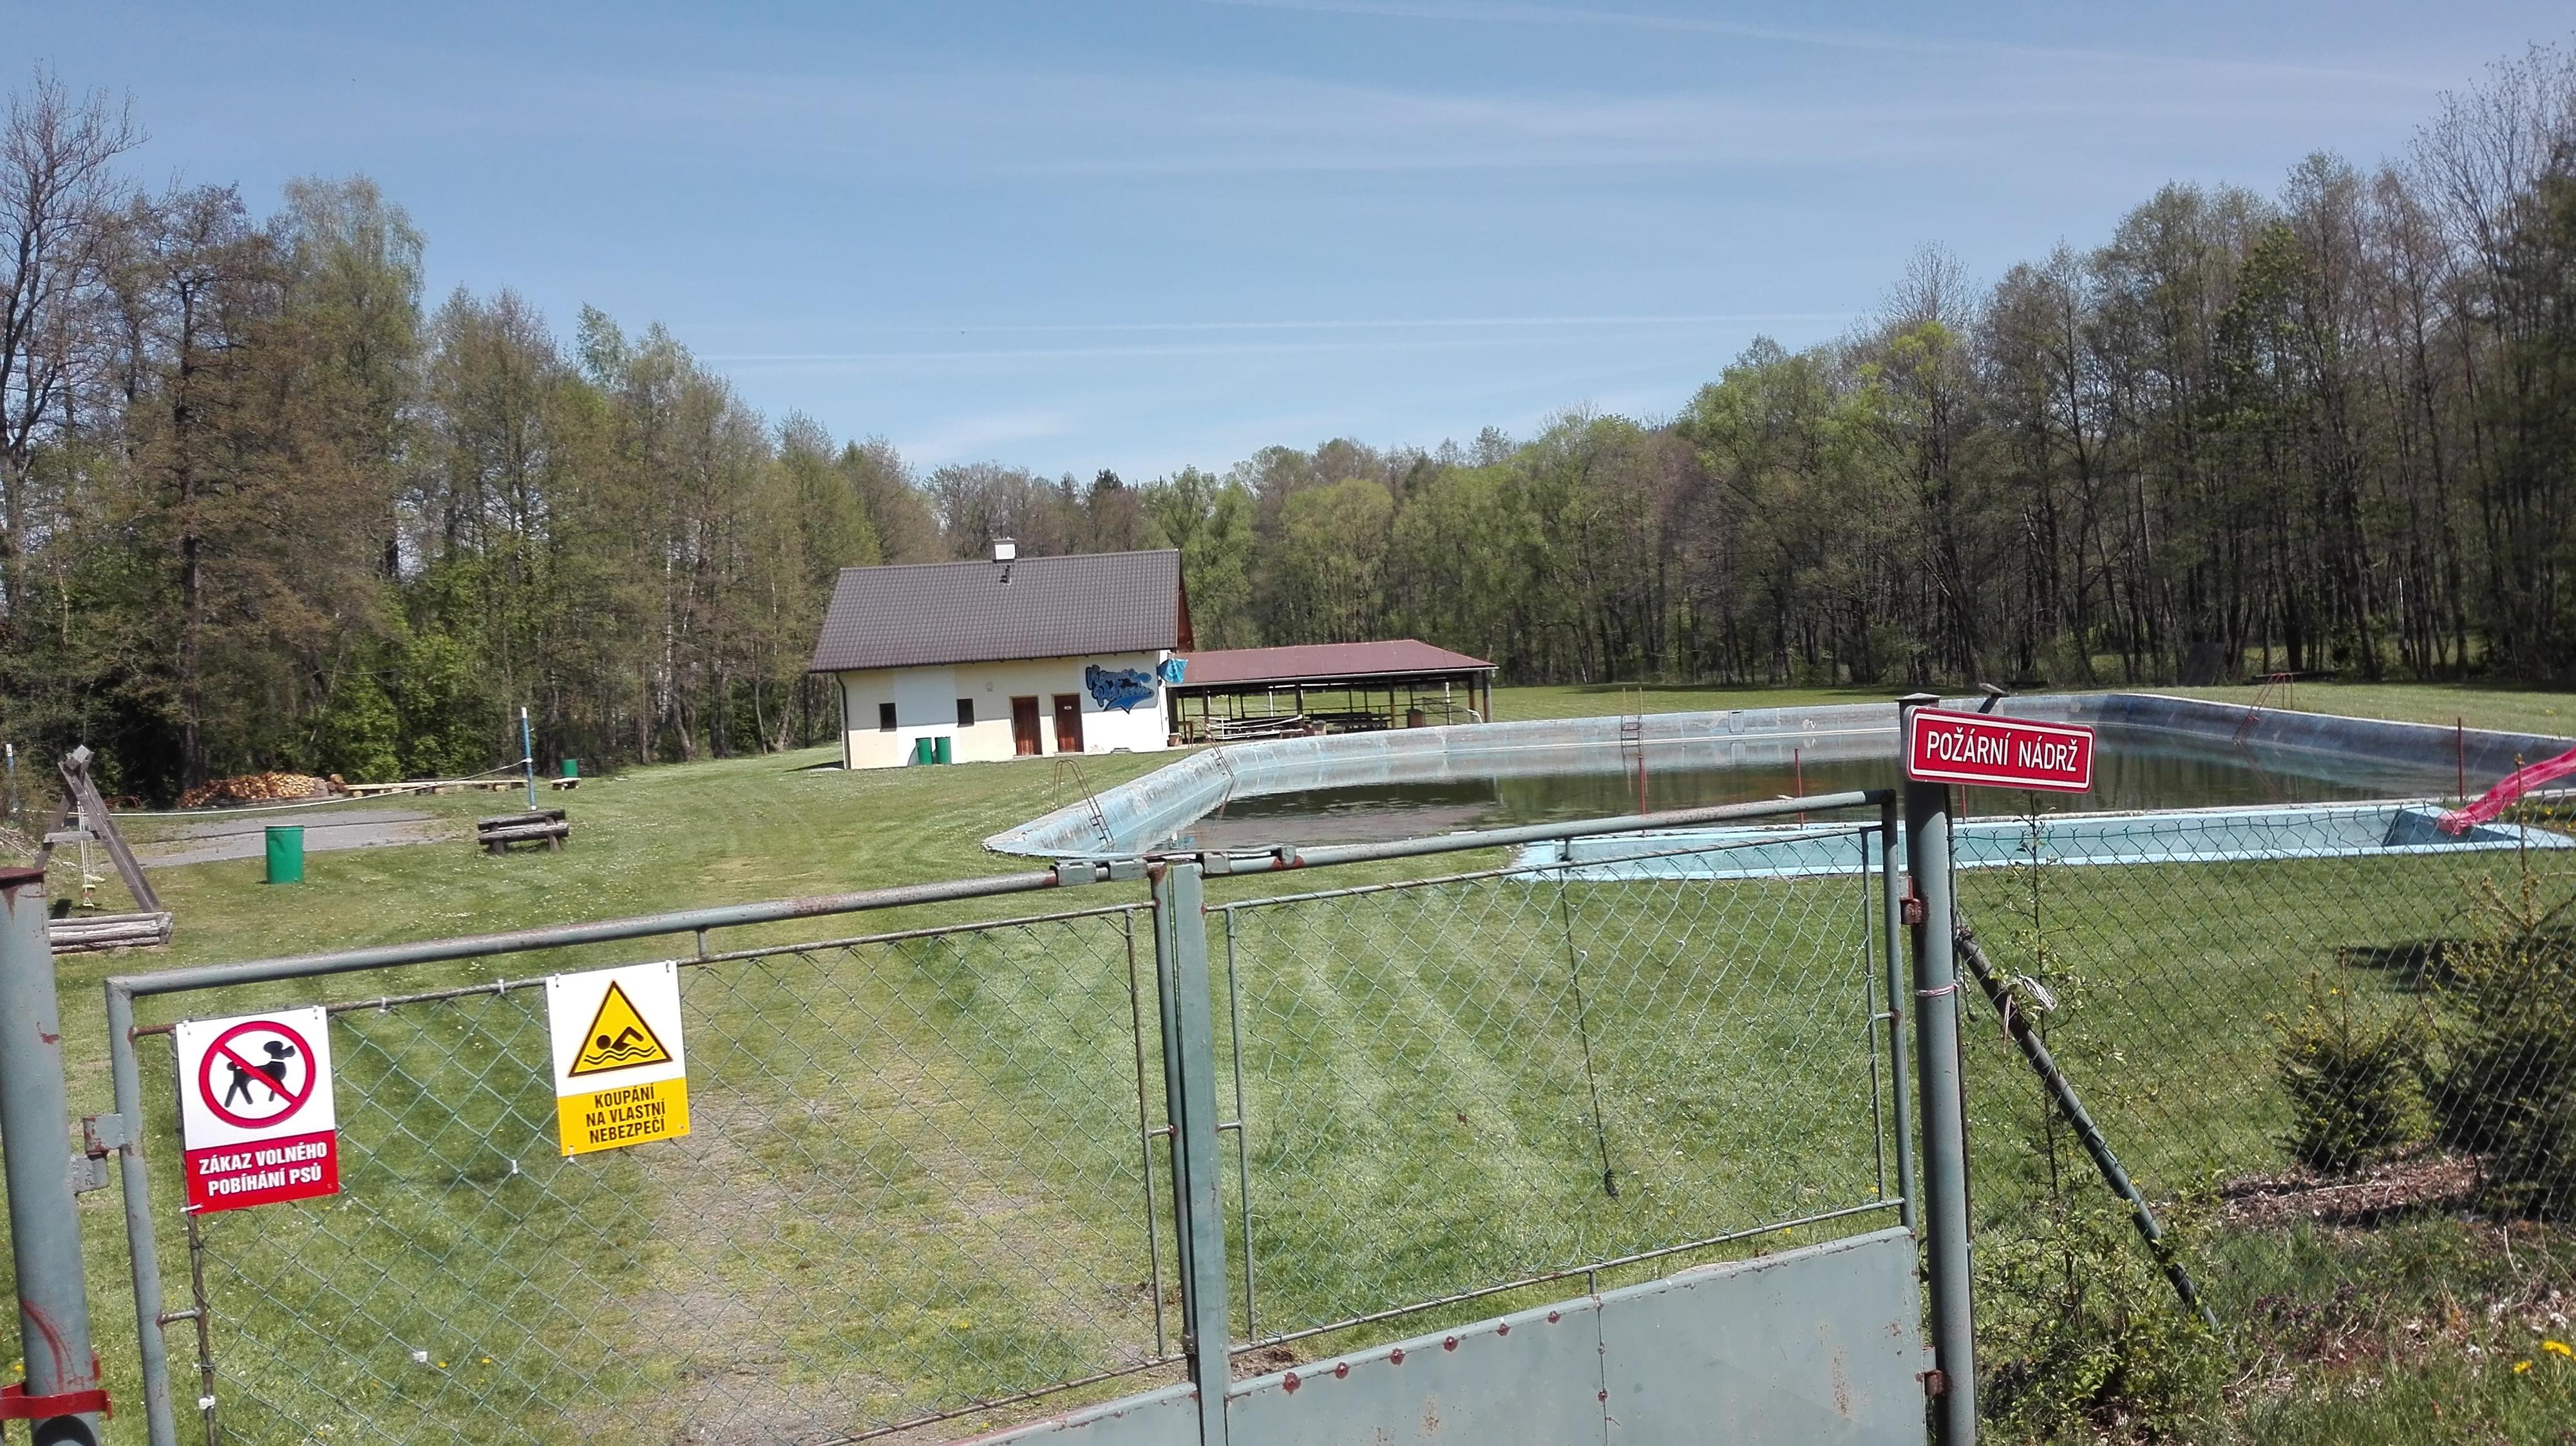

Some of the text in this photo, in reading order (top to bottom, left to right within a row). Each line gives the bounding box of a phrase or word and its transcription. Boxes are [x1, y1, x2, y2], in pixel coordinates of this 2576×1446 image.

[1927, 727, 2078, 772] POŽÁRNÍ NÁDRŽ
[595, 1084, 654, 1108] KOUPÁNÍ
[586, 1099, 665, 1127] NA VLASTNÍ
[590, 1116, 665, 1143] NEBEZPEČÍ
[199, 1141, 327, 1174] ZÁKAZ VOLNÉHO
[209, 1163, 321, 1196] POBÍHÁNÍ PSŮ
